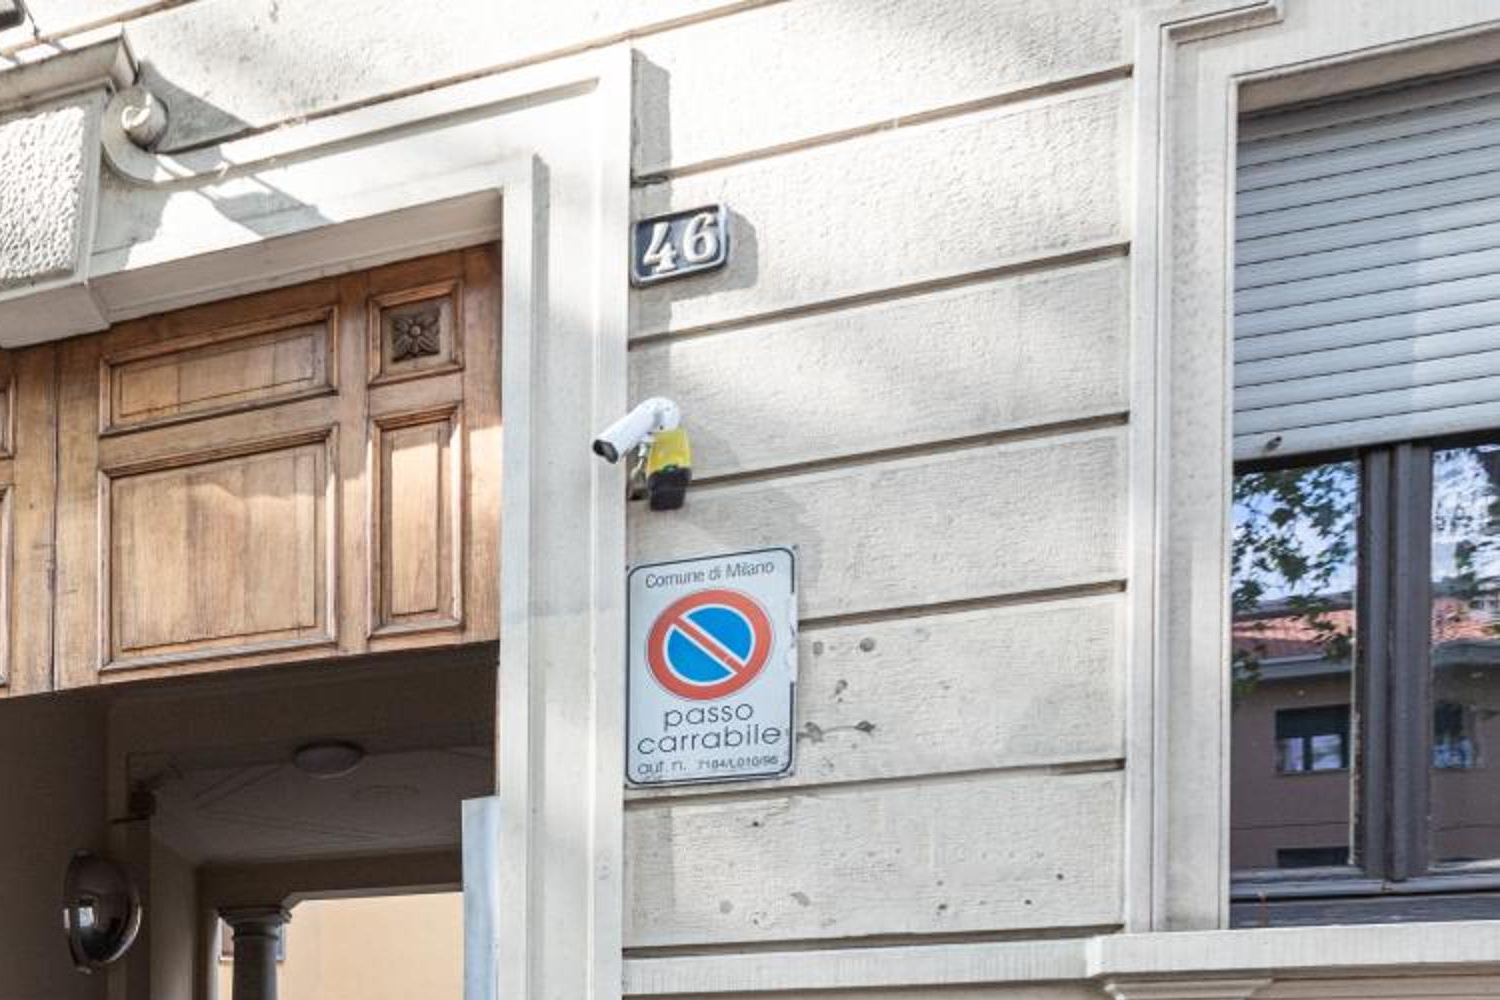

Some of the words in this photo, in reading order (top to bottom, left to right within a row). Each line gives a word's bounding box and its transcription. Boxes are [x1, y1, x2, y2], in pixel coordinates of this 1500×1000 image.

[643, 213, 718, 272] 46
[645, 571, 705, 588] Comune
[708, 566, 721, 581] di
[726, 561, 775, 578] Milano
[664, 703, 753, 731] passo
[638, 724, 781, 754] carrabile
